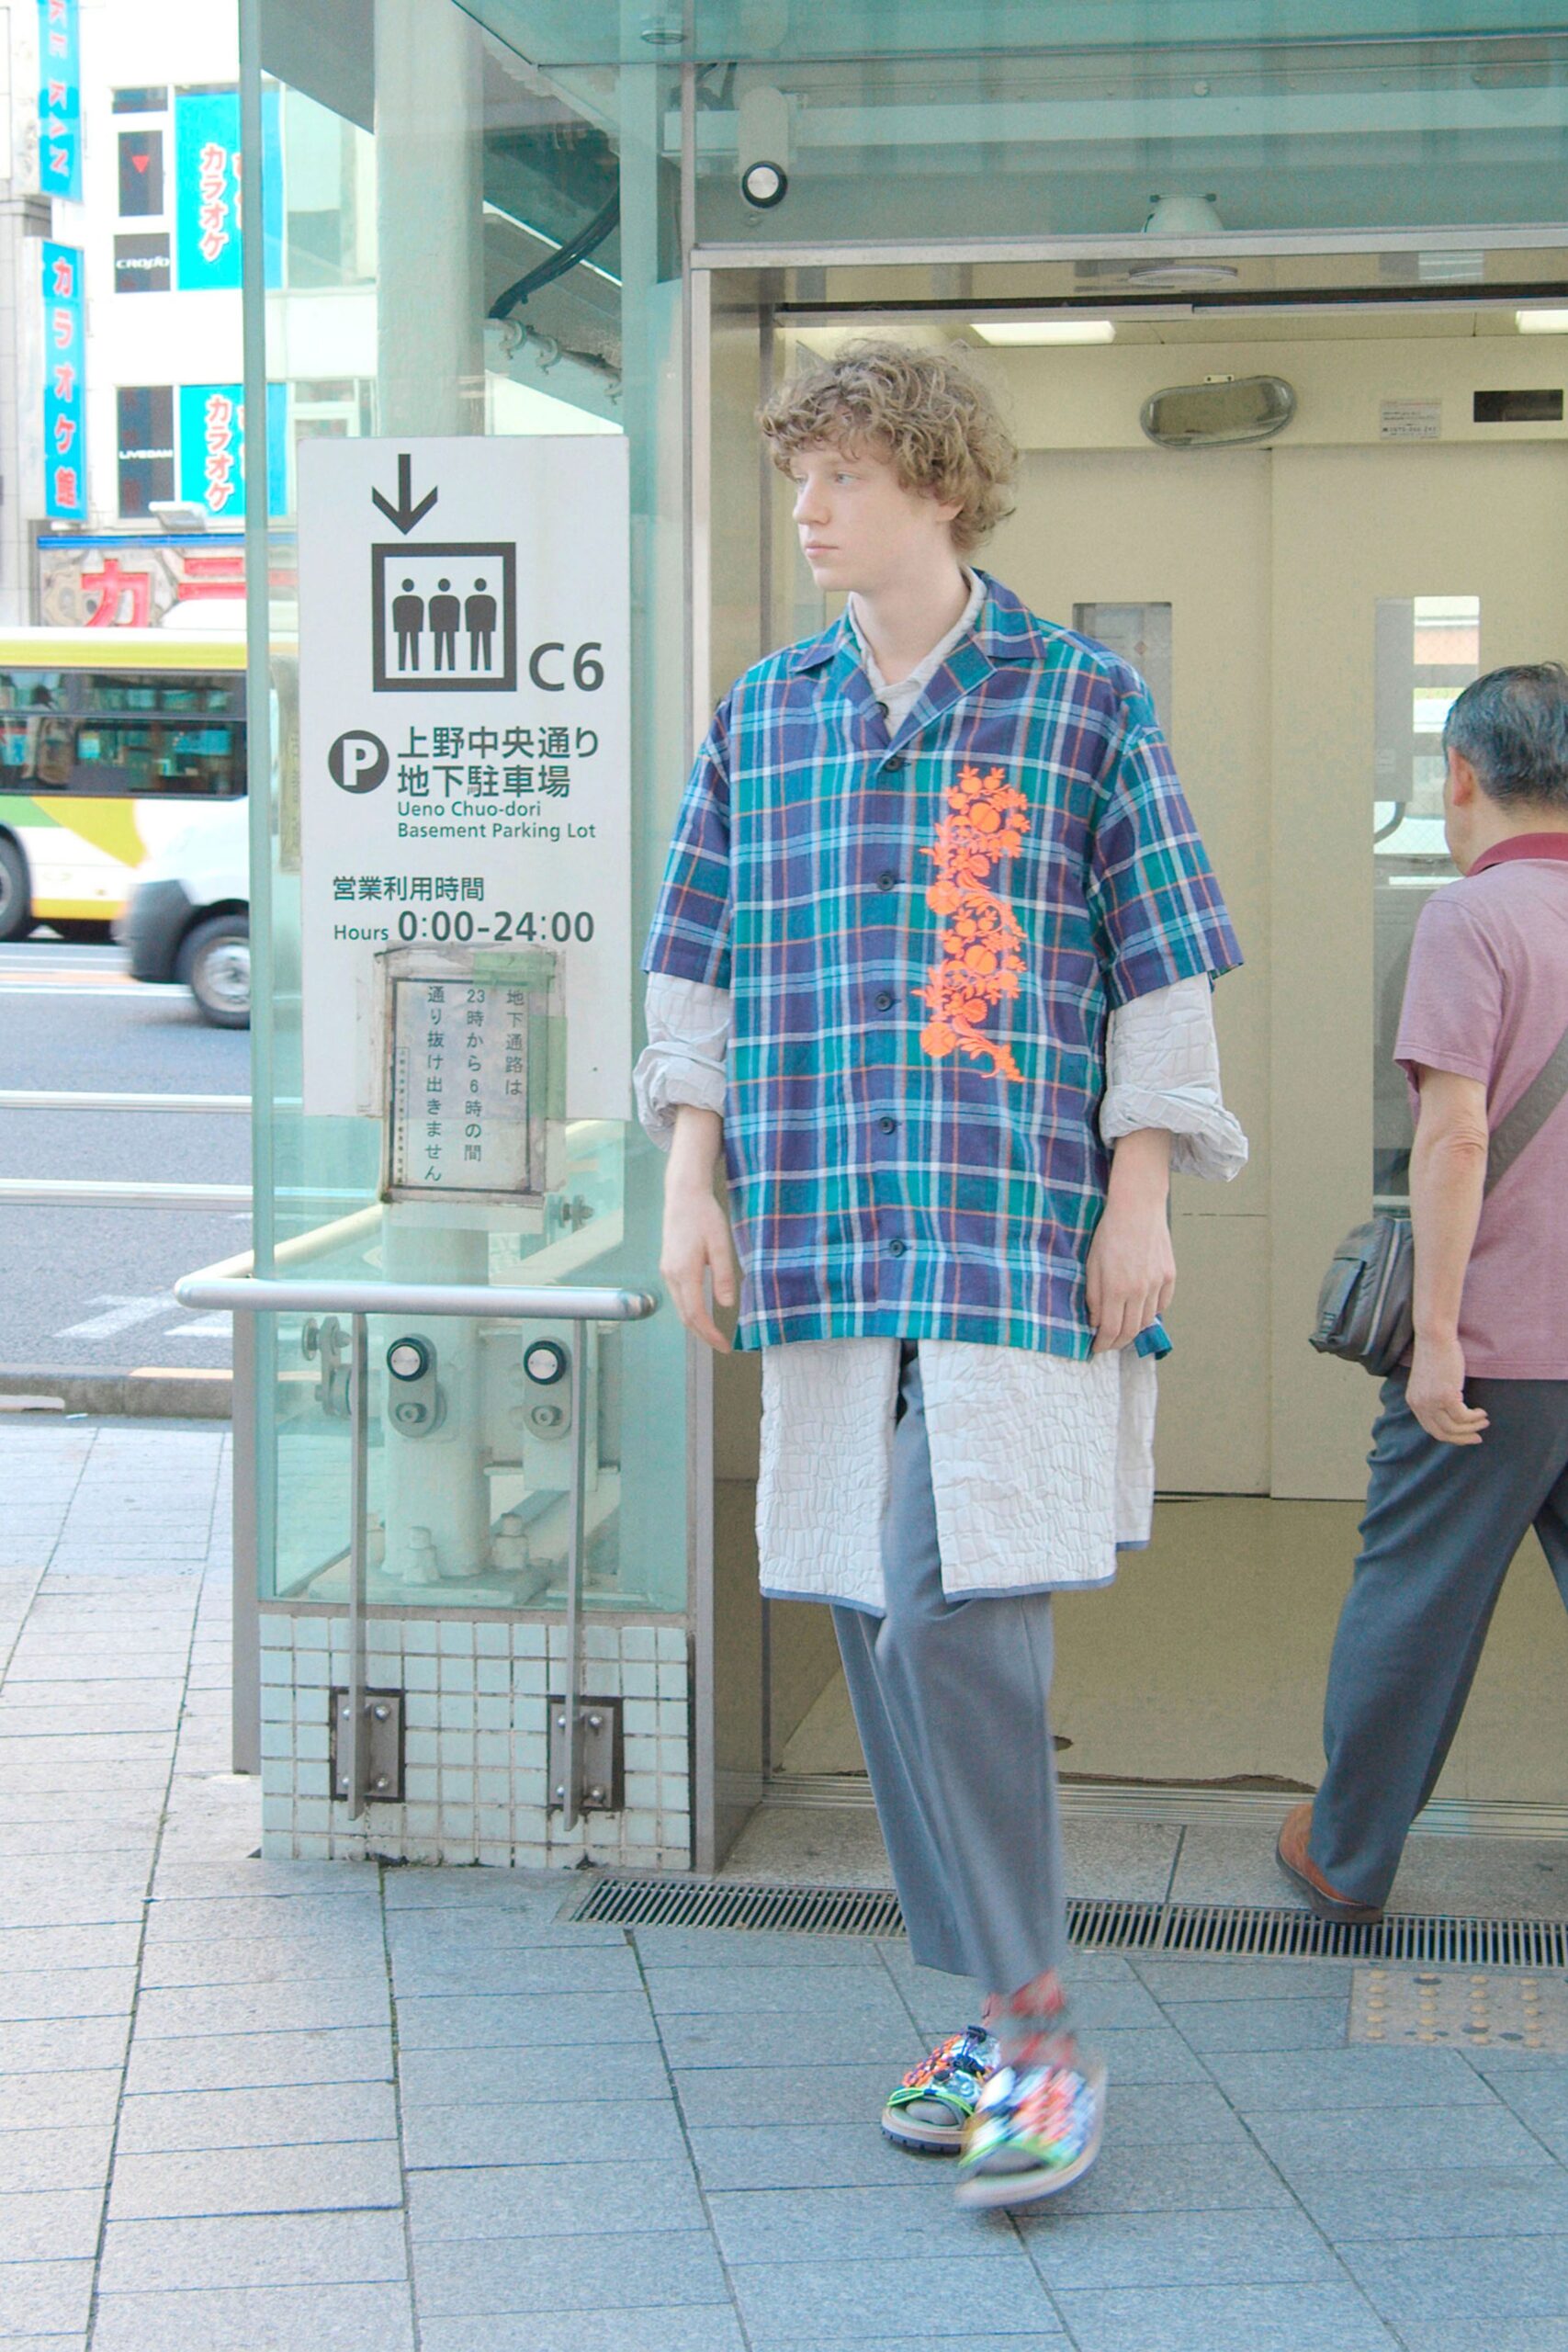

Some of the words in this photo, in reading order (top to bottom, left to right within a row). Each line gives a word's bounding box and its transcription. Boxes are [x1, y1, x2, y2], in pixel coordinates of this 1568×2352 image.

[201, 143, 228, 260] カラオケ
[53, 258, 76, 507] カラオケ館
[206, 395, 232, 510] カラオケ
[528, 641, 605, 693] C6
[342, 739, 379, 787] P
[397, 725, 599, 760] 上野中央通り
[397, 763, 571, 798] 地下駐車場
[398, 800, 446, 817] Ueno
[451, 800, 541, 817] Chuo-dori
[398, 822, 487, 839] Basement
[492, 821, 560, 842] Parking
[567, 822, 596, 839] Lot
[333, 876, 485, 902] 営業利用時間
[333, 924, 389, 941] Hours
[398, 910, 594, 943] 0:00-24:00
[505, 989, 525, 1097] 地下通路は
[424, 986, 446, 1182] 通り抜け出きません
[464, 989, 486, 1162] 23時から6時の間
